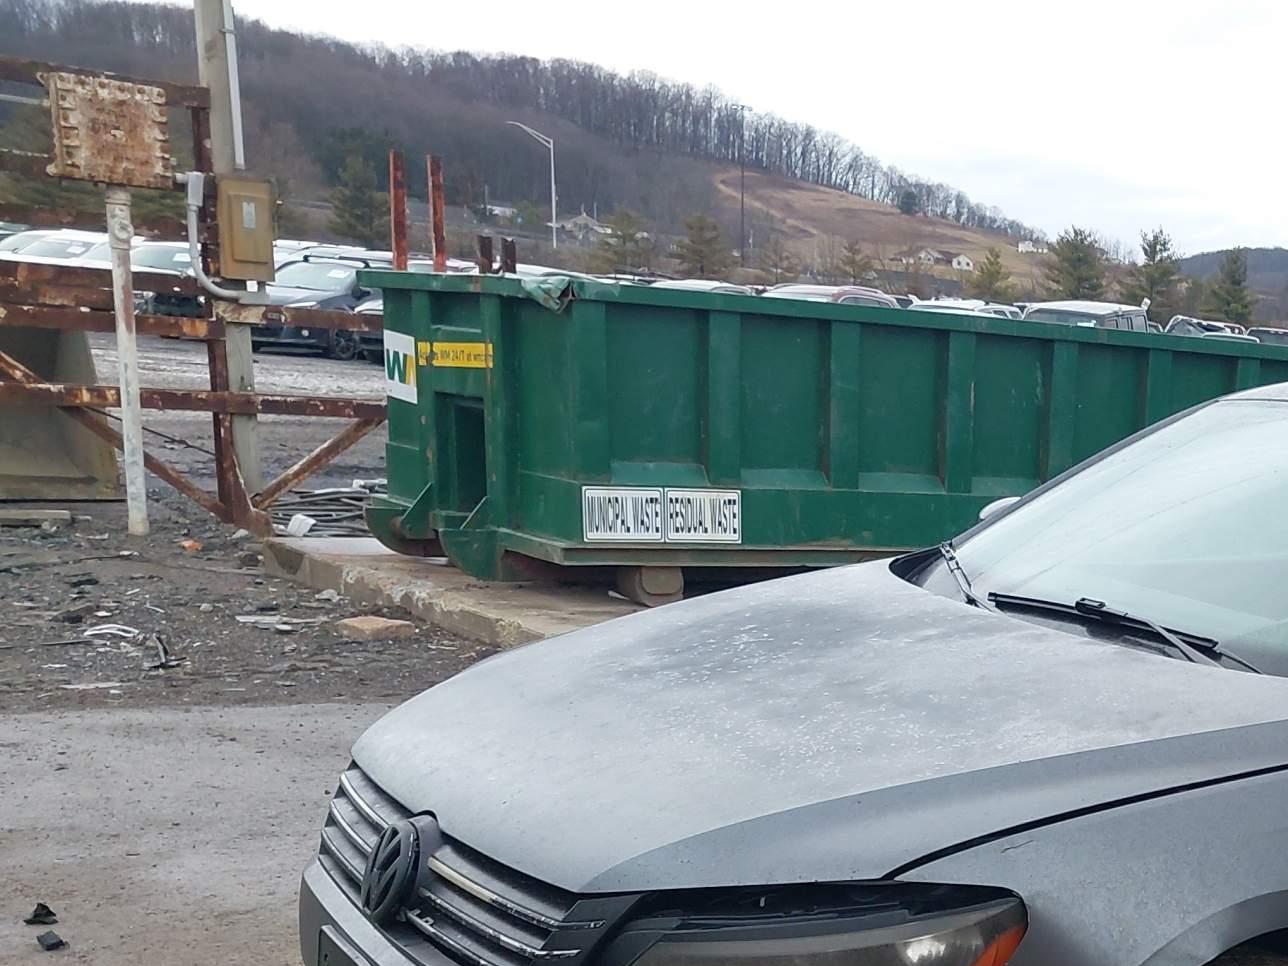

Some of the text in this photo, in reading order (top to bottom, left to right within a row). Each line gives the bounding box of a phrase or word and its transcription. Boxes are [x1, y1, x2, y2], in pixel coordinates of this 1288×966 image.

[587, 495, 660, 534] MUNICIPAL WASTE
[669, 496, 737, 535] RESIDUAL WASTE
